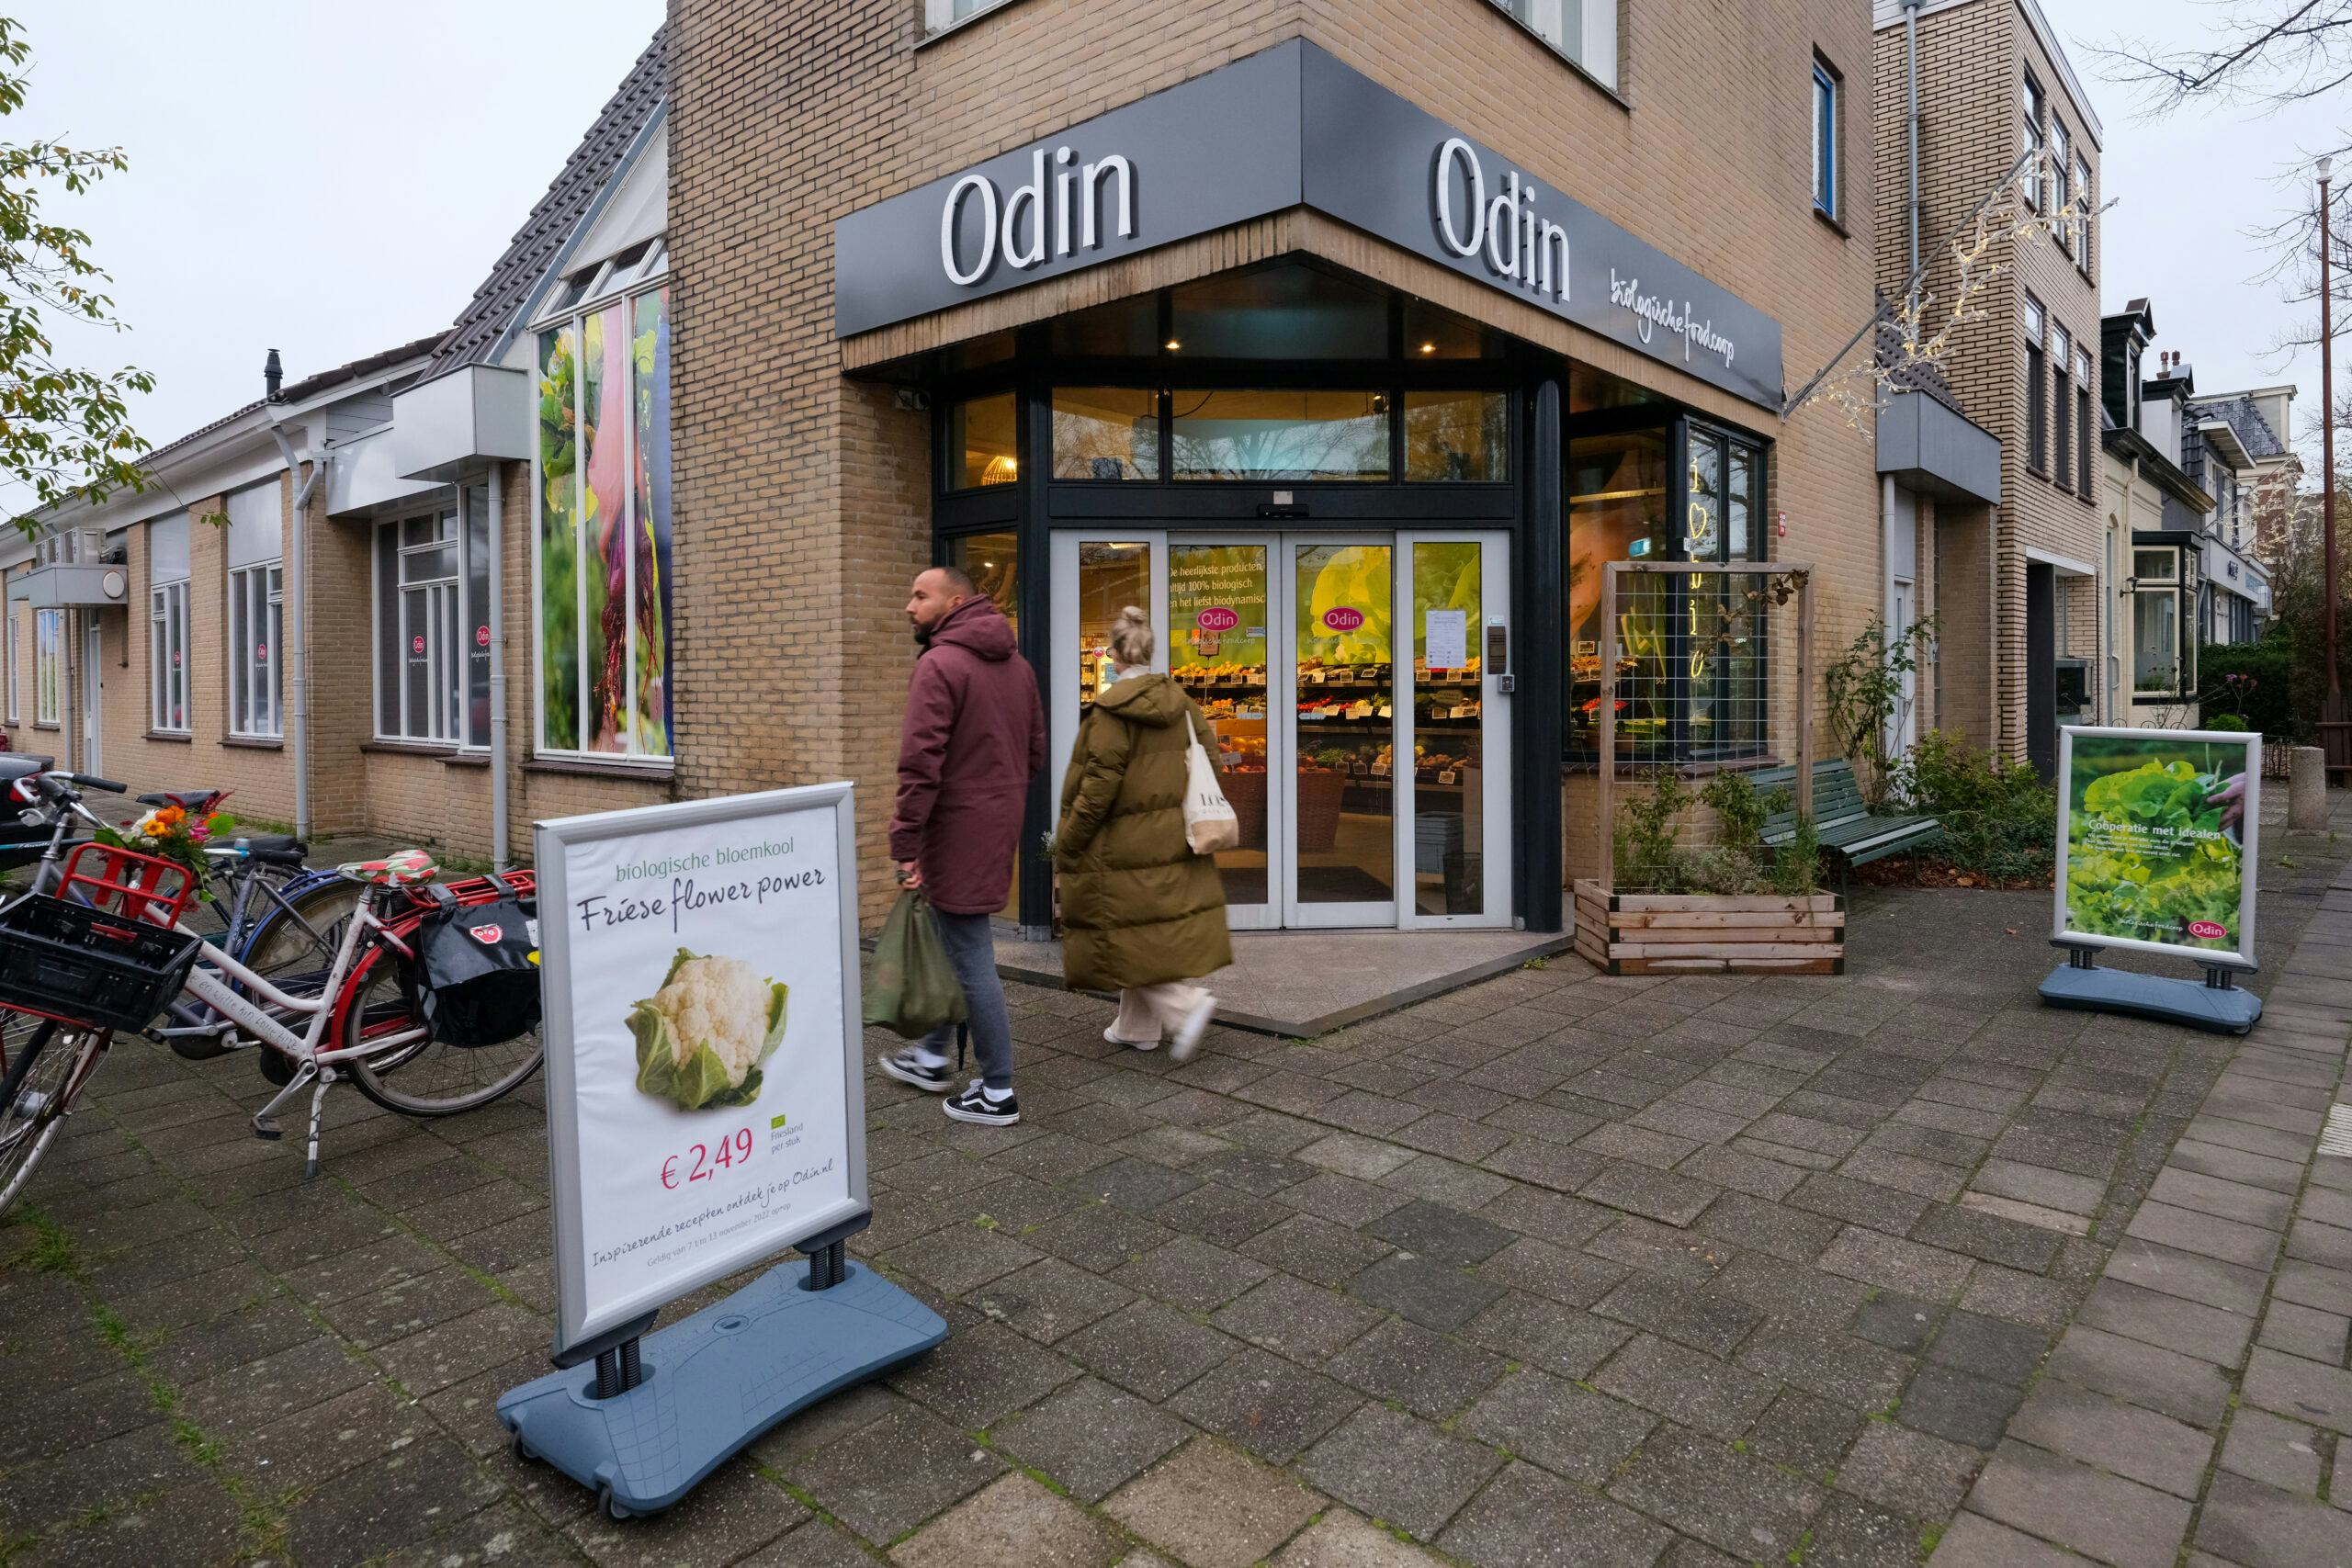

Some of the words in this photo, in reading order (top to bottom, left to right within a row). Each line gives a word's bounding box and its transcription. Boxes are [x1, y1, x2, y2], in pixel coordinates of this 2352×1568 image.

[941, 146, 1132, 286] Odin
[1438, 138, 1570, 302] Odin
[1611, 268, 1685, 344] biologische
[1683, 302, 1735, 369] foodcoop
[1180, 565, 1219, 578] heerlijkste
[1221, 561, 1264, 576] producten,
[1188, 581, 1210, 592] 100%
[1212, 578, 1253, 591] biologisch
[1180, 598, 1192, 607] het
[1193, 595, 1212, 606] liefst
[1214, 593, 1265, 607] biodynamisc
[1201, 613, 1234, 626] Odin
[1327, 613, 1360, 626] Odin
[2088, 819, 2148, 834] Coöperatie
[2152, 826, 2175, 836] met
[2178, 827, 2222, 840] idealen
[616, 852, 710, 882] biologische
[717, 837, 794, 864] bloemkool
[577, 896, 666, 931] Friese
[672, 877, 752, 933] flower
[757, 869, 826, 904] power
[2192, 923, 2222, 936] Odin
[771, 1122, 804, 1142] Friesland
[771, 1144, 783, 1155] per
[786, 1136, 801, 1147] stuk
[661, 1155, 680, 1190] €
[689, 1127, 752, 1182] 2,49
[593, 1224, 673, 1268] Inspirerende
[675, 1207, 724, 1232] recepten
[727, 1186, 763, 1212] ontdek
[761, 1182, 776, 1209] je
[778, 1179, 790, 1193] op
[647, 1251, 672, 1268] Geldig
[673, 1246, 686, 1257] van
[709, 1231, 718, 1241] 13
[718, 1219, 752, 1237] november
[753, 1209, 770, 1224] 2022
